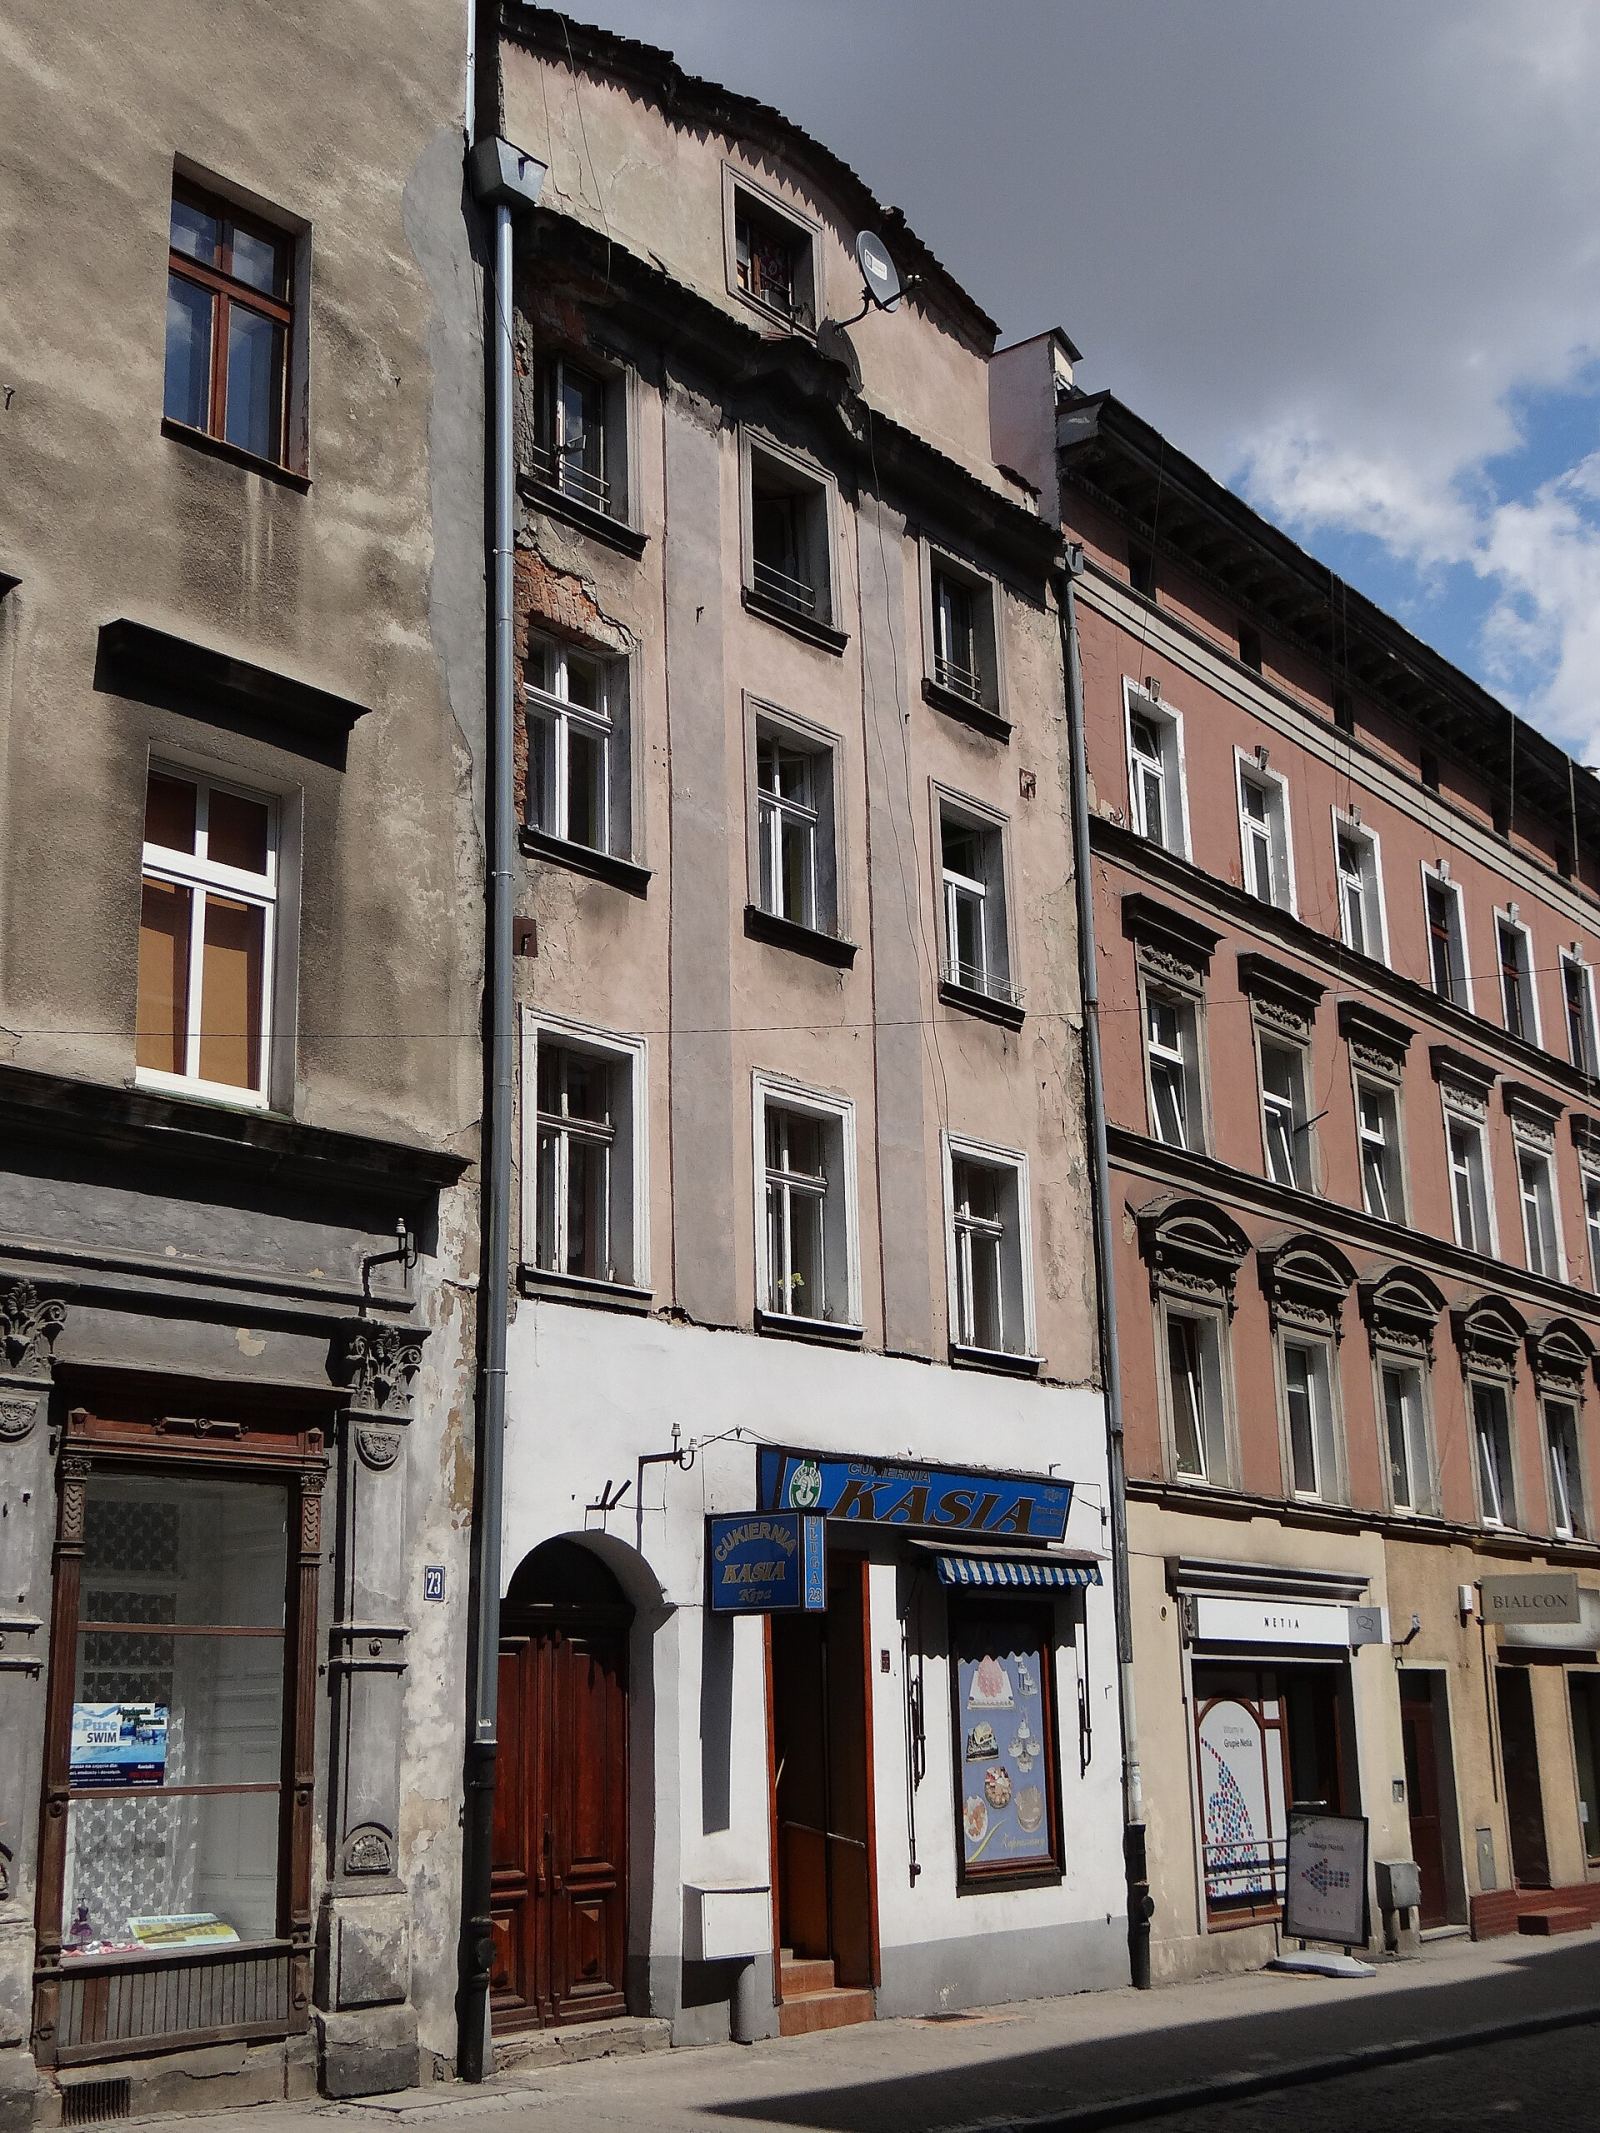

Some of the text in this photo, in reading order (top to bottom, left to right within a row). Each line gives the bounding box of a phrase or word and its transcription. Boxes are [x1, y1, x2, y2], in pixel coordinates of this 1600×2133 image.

[830, 1478, 1036, 1534] KASIA
[714, 1521, 797, 1562] CUKIERNIA
[721, 1560, 786, 1584] KASIA
[427, 1571, 441, 1595] 23
[808, 1587, 822, 1603] 23
[1492, 1592, 1568, 1609] BIALCON
[1264, 1617, 1299, 1629] NETIA
[82, 1718, 118, 1732] Pure
[86, 1732, 117, 1744] SWIM
